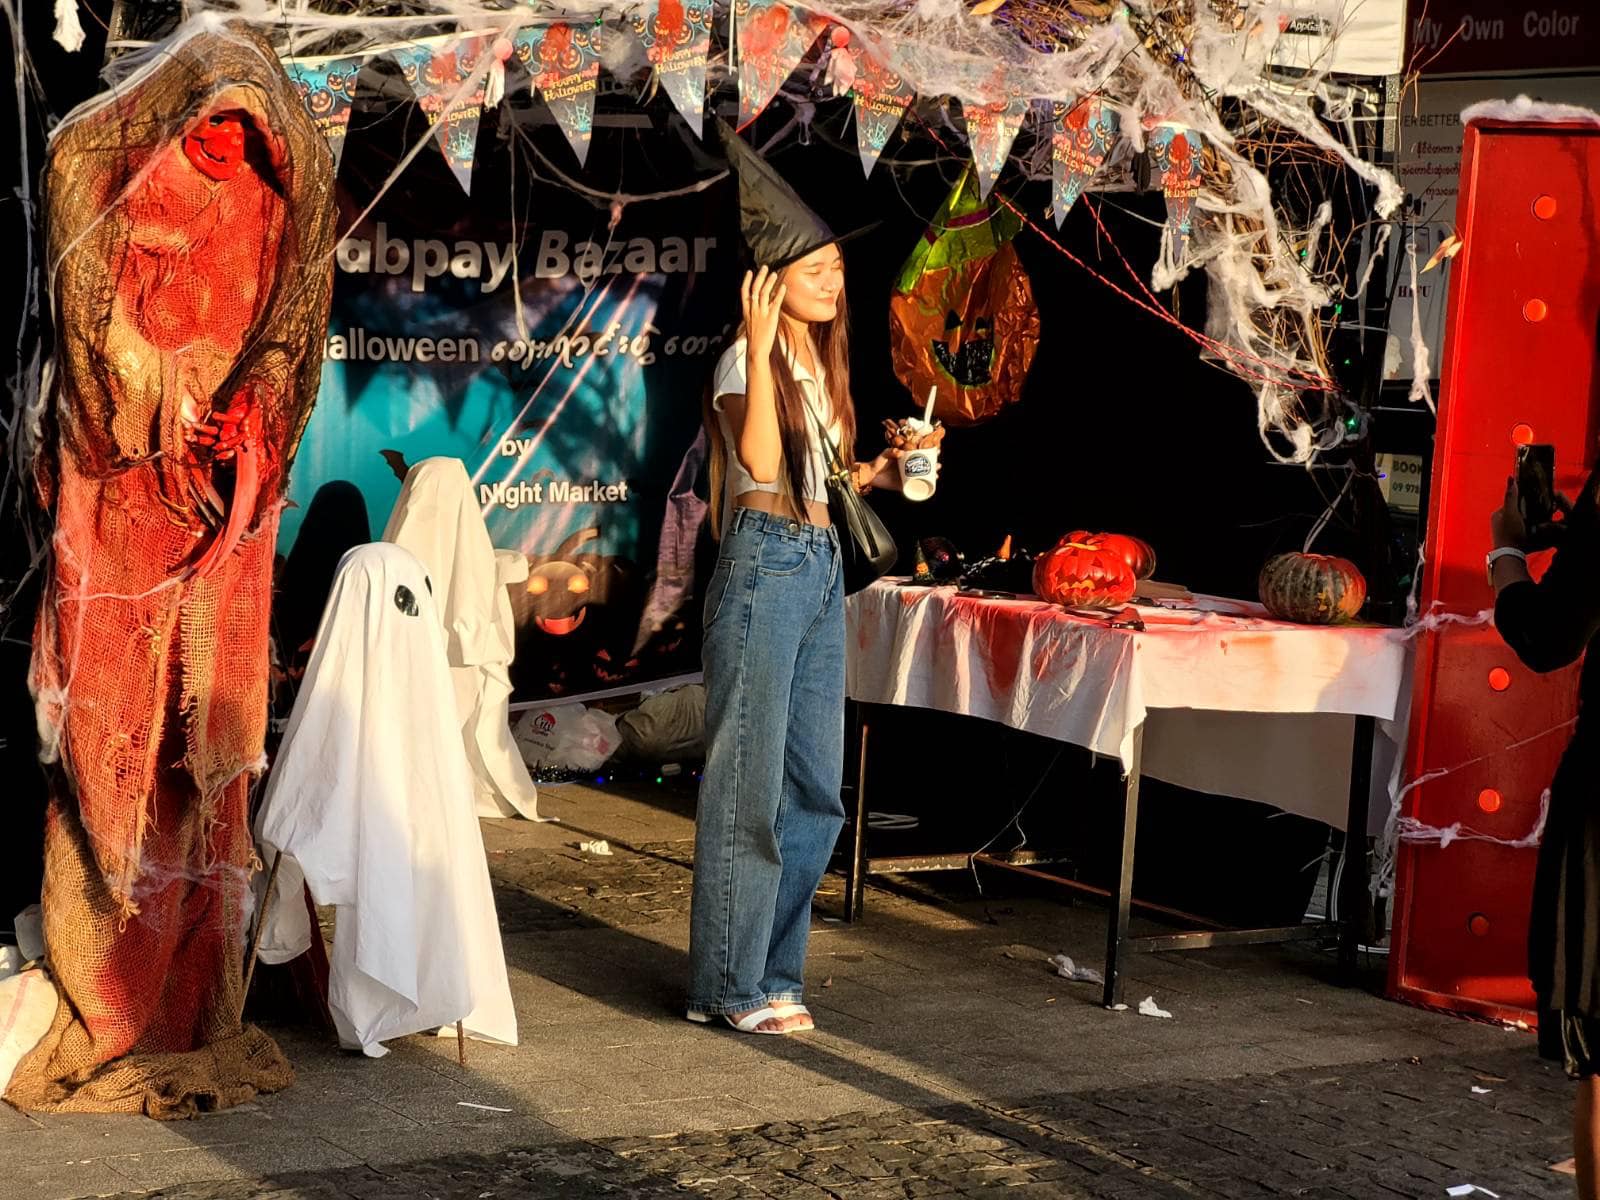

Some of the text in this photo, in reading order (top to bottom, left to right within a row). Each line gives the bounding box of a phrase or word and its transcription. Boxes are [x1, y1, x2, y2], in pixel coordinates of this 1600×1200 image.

[1412, 9, 1580, 49] My Own Color
[535, 230, 717, 278] Bazaar
[501, 436, 532, 461] by
[479, 479, 628, 509] Night Market
